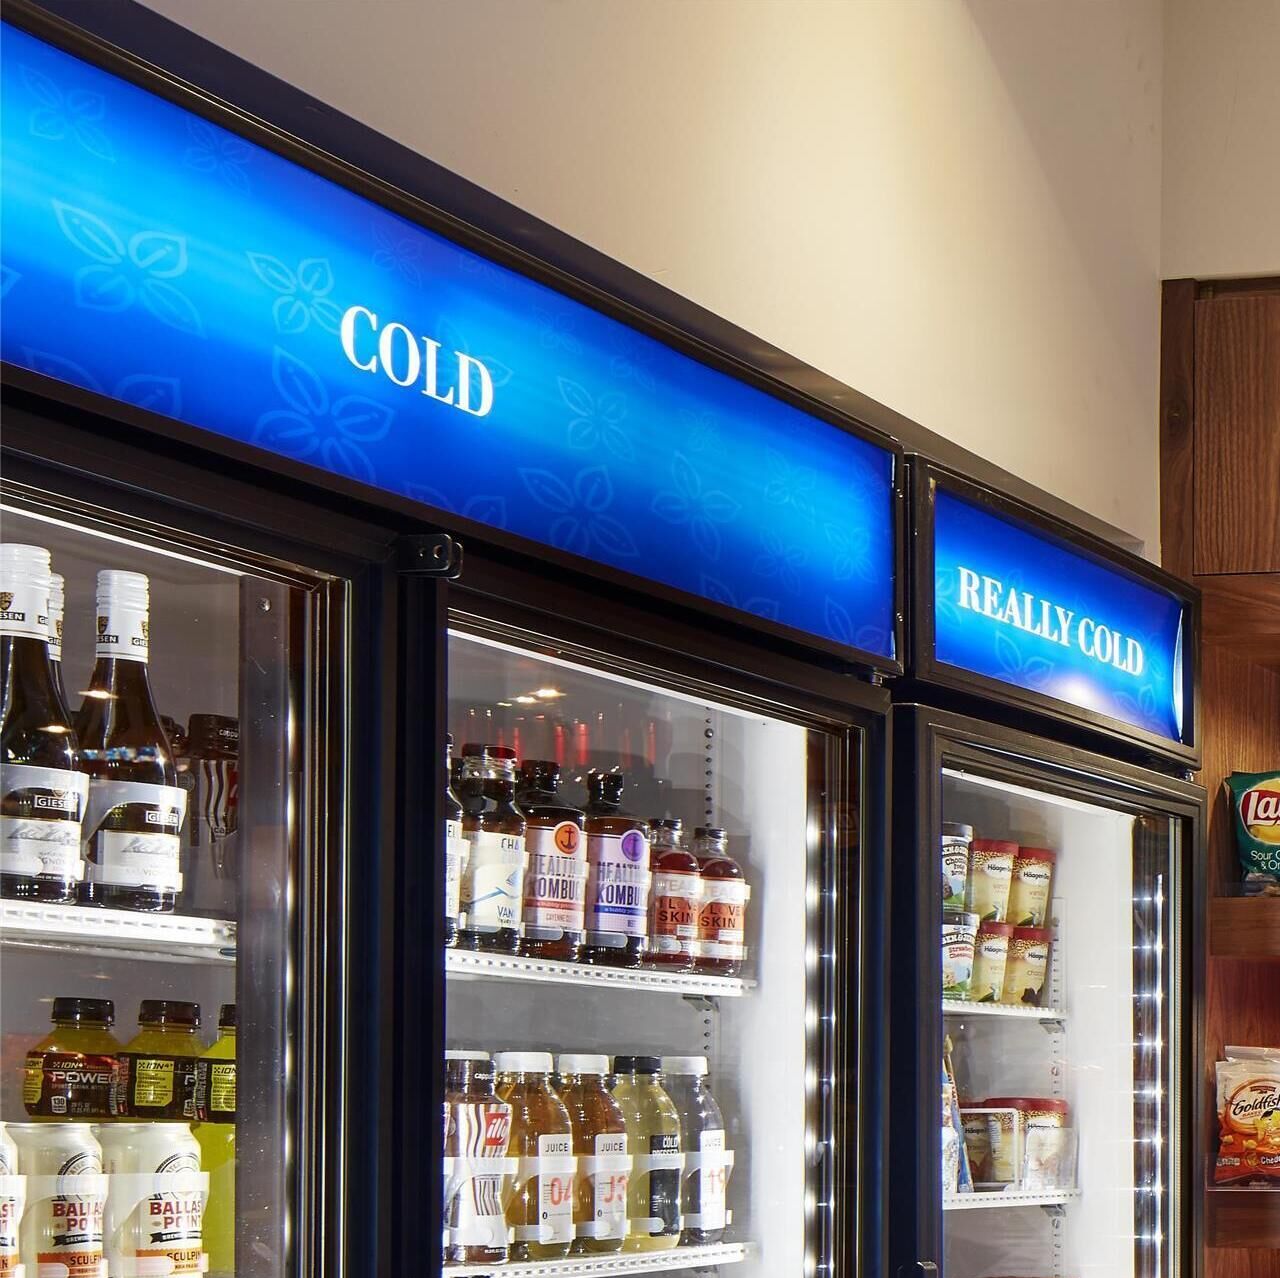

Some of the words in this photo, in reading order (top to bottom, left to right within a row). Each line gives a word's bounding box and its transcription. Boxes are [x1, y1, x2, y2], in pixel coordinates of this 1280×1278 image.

[340, 305, 494, 417] COLD
[957, 567, 1074, 646] REALLY
[1077, 617, 1144, 677] COLD
[1250, 850, 1273, 861] Sour
[1261, 861, 1267, 870] &
[701, 916, 736, 929] SKIN
[545, 1142, 569, 1153] JUICE
[601, 1141, 623, 1152] JUICE
